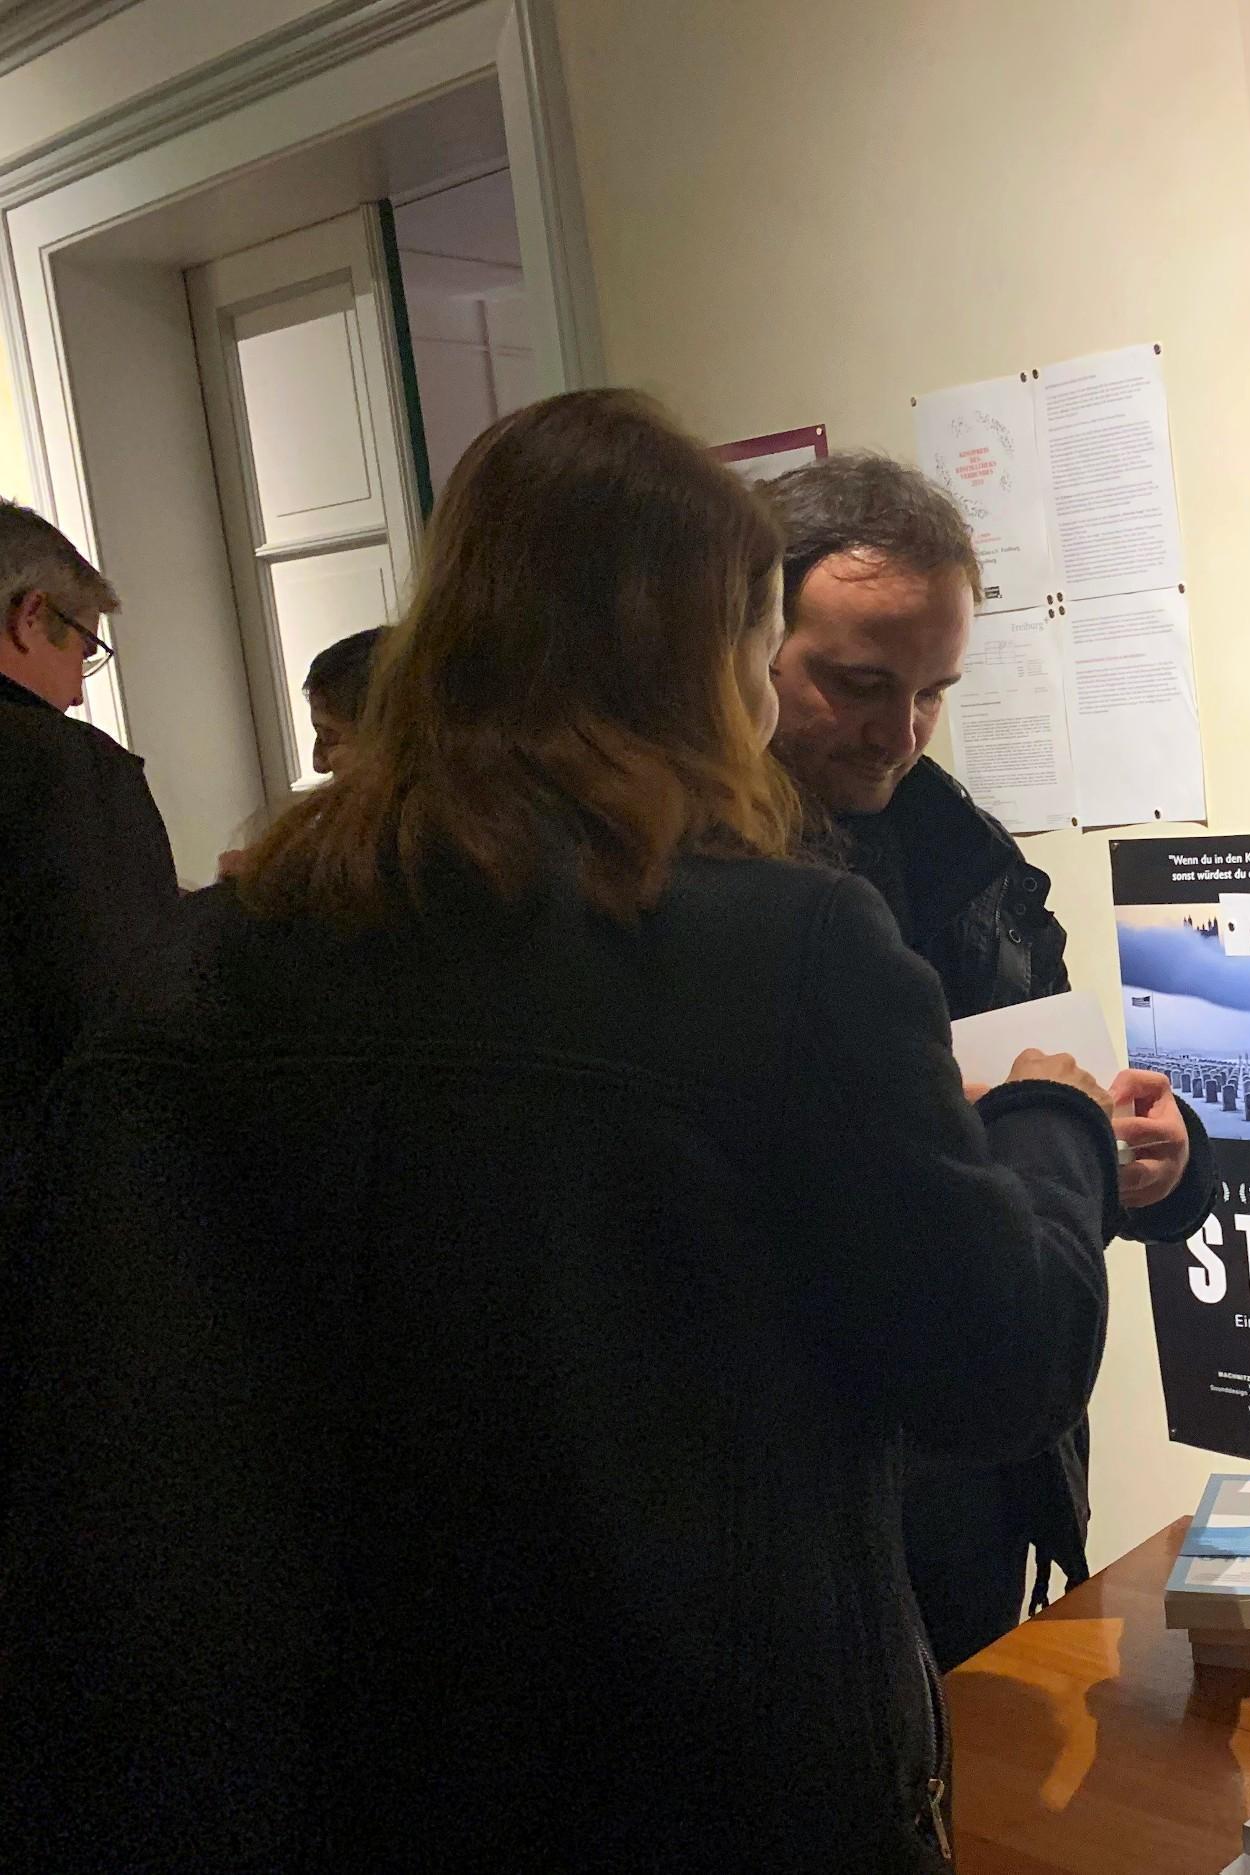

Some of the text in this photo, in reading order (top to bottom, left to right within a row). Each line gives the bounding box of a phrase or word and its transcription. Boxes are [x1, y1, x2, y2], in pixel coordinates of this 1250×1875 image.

[1168, 854, 1199, 867] "Wenn
[1201, 853, 1212, 865] du
[1214, 854, 1224, 864] in
[1226, 853, 1242, 864] den
[1172, 871, 1195, 882] sonst
[1197, 868, 1233, 881] würdest
[1235, 868, 1246, 880] du
